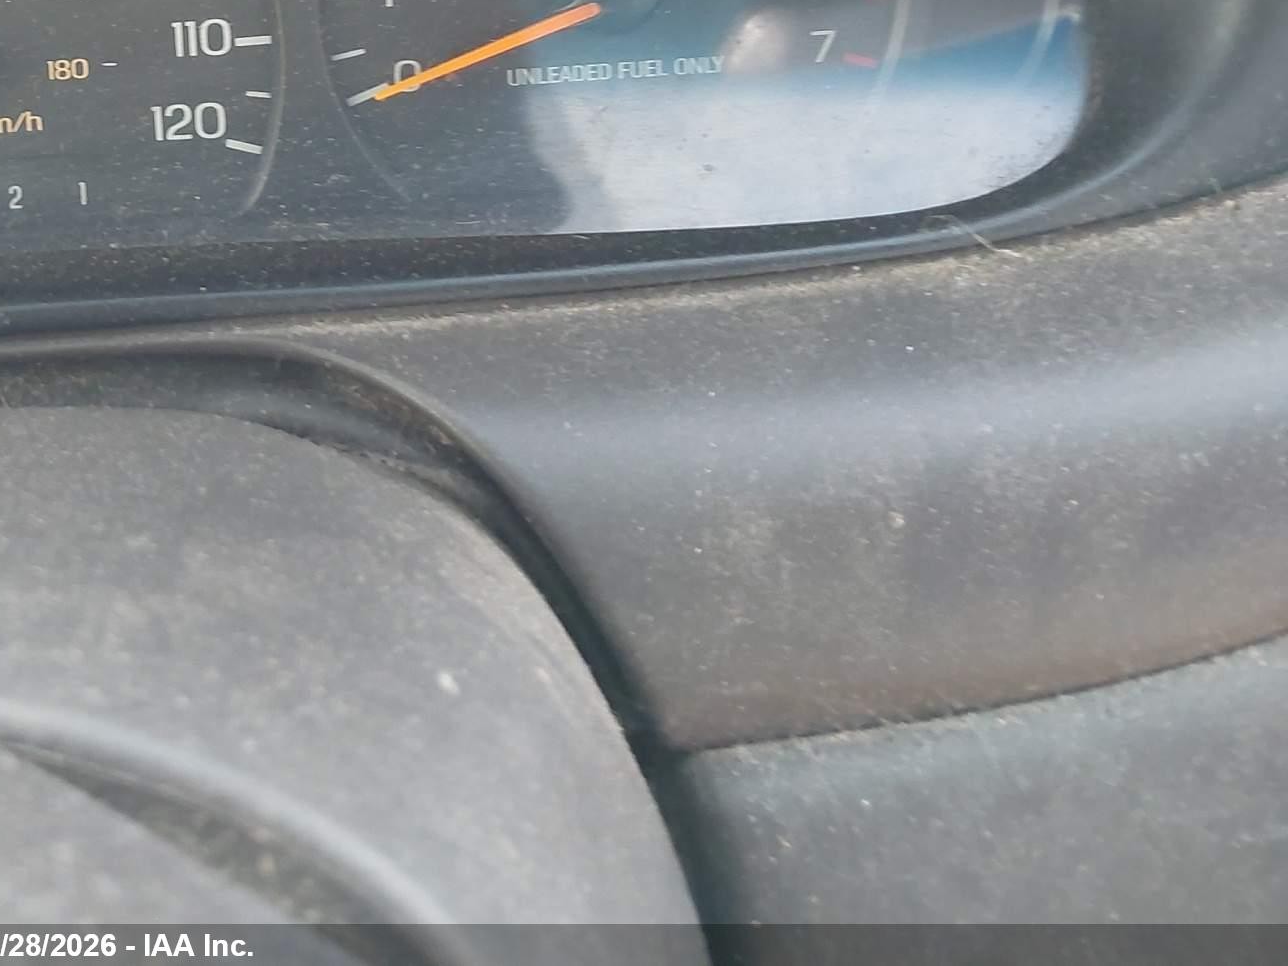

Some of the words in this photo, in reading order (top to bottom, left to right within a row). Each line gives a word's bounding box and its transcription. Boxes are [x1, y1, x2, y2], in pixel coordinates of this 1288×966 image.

[171, 18, 233, 58] 110
[810, 29, 838, 64] 7
[47, 57, 89, 81] 180
[507, 63, 612, 86] UNLEADED
[617, 59, 669, 80] FUEL
[673, 55, 725, 76] ONLY
[150, 102, 227, 141] 120
[8, 186, 25, 210] 2
